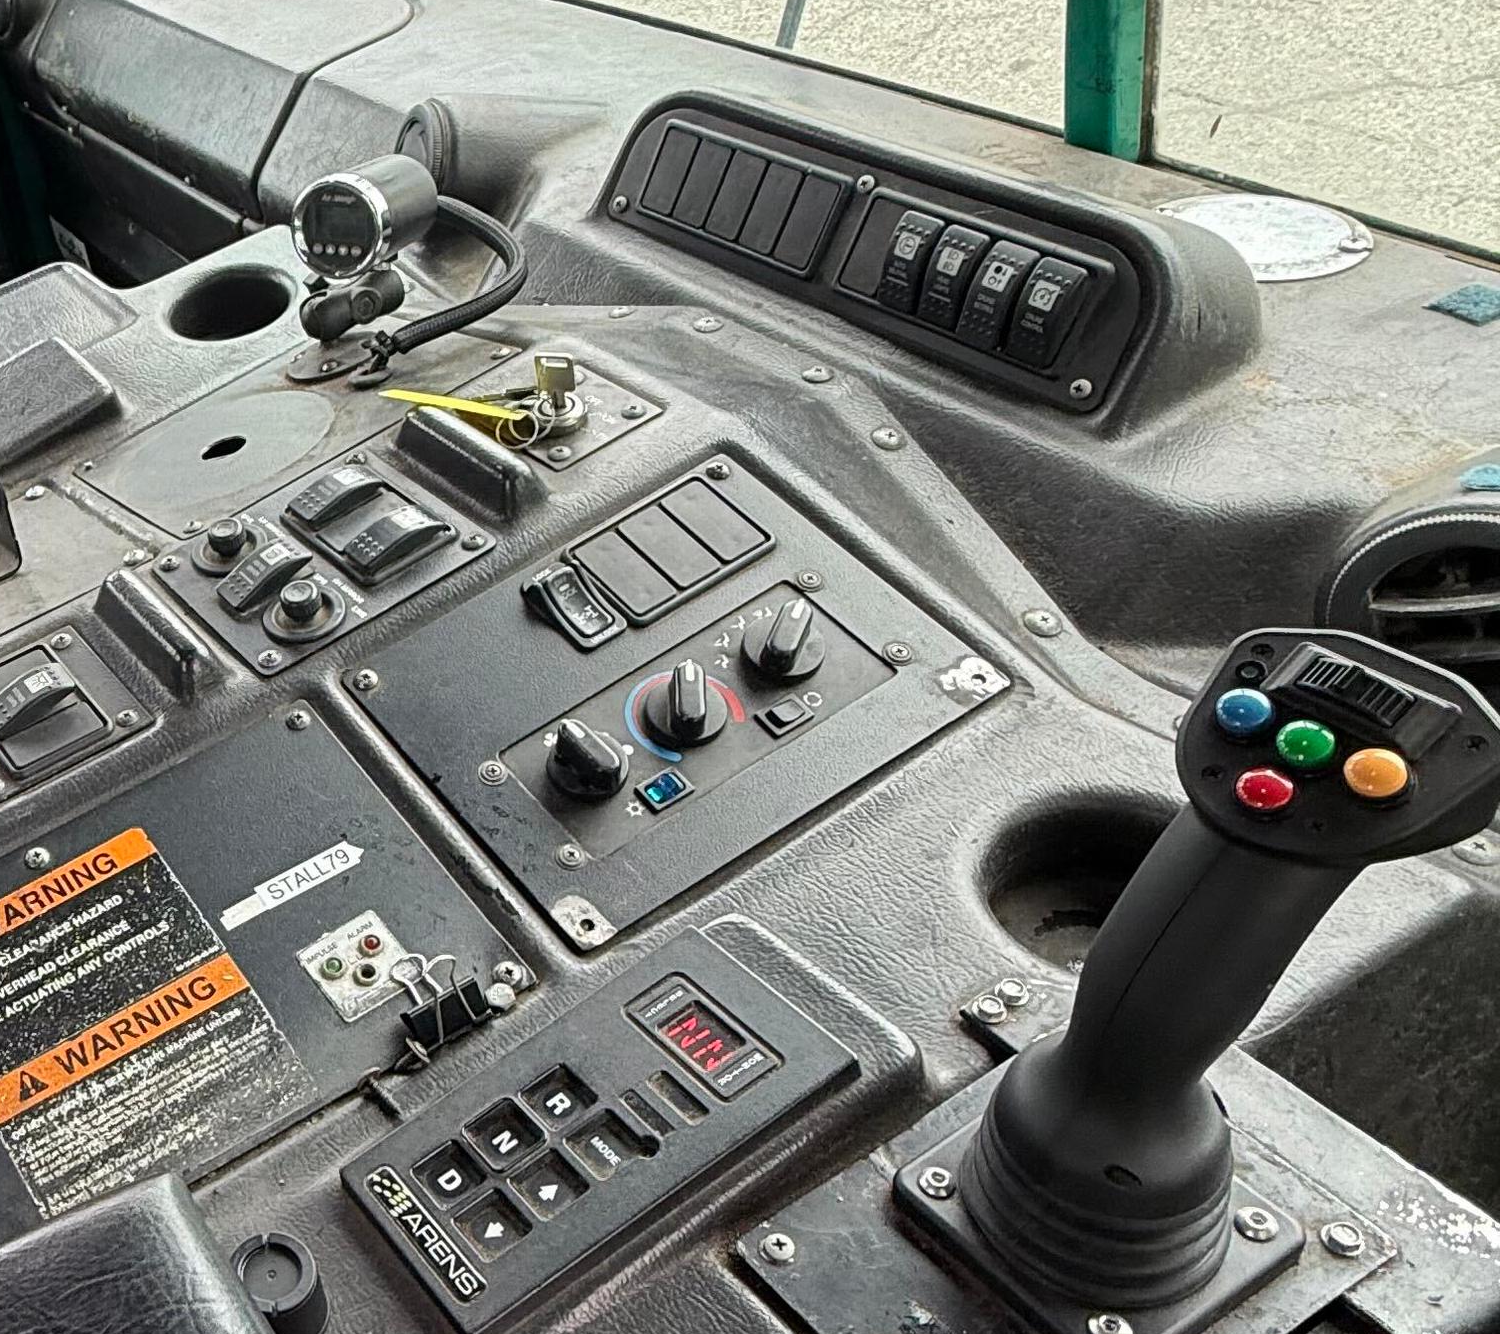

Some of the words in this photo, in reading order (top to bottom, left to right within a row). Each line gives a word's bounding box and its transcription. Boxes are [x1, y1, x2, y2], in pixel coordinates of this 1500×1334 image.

[265, 846, 352, 901] STALL79
[70, 892, 126, 929] HAZARD
[52, 918, 133, 967] CLEARANCE
[344, 920, 374, 940] ALARM
[1, 970, 77, 1018] ACTUATING
[73, 954, 105, 979] ANY
[99, 917, 172, 963] CONTROLS
[303, 941, 339, 964] IMPULSE
[51, 971, 221, 1078] WARNING
[544, 1090, 573, 1118] R
[490, 1128, 520, 1156] N
[589, 1135, 622, 1167] MODE
[435, 1167, 464, 1194] D
[401, 1212, 479, 1296] ARENS
